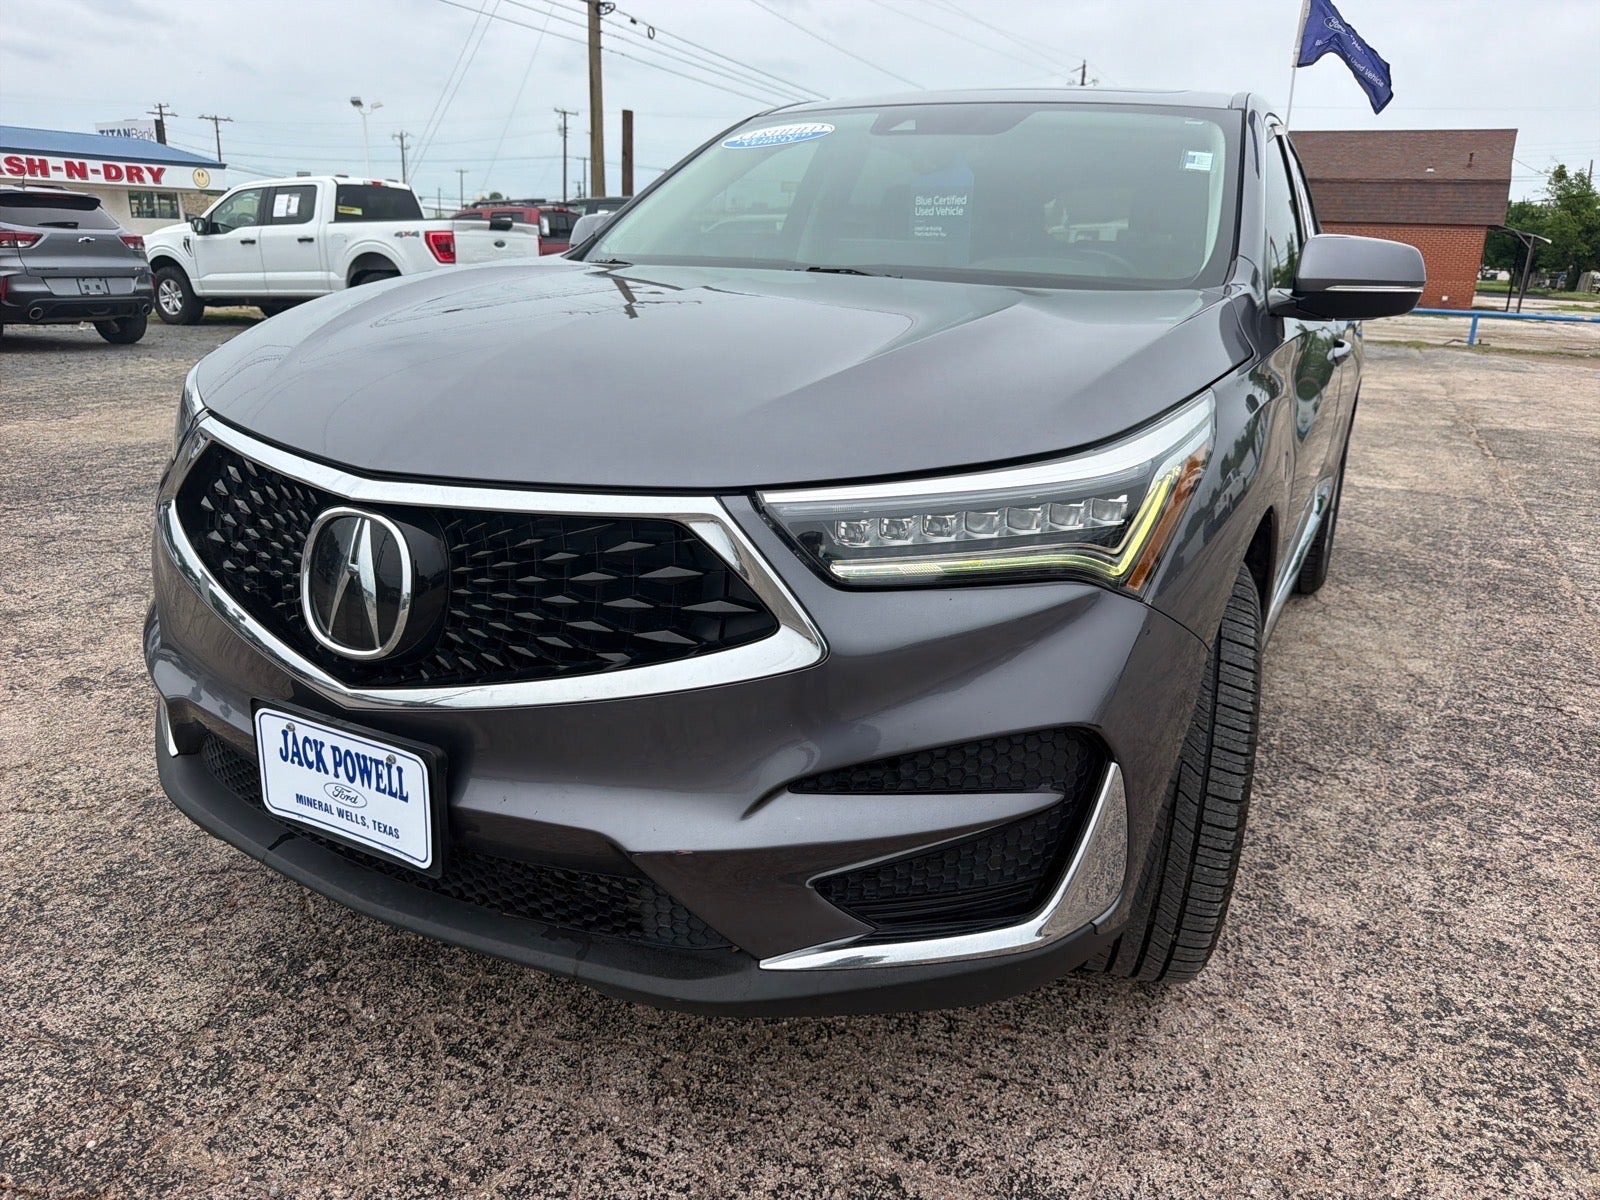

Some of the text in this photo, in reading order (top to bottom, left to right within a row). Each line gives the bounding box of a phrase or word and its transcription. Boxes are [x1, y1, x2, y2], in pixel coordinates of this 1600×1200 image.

[1350, 57, 1385, 88] Used Vehicle
[0, 155, 166, 184] SH-N-DRY
[914, 206, 964, 216] Used Vehicle
[915, 194, 967, 206] Blue Certified
[279, 729, 408, 803] JACK POWELL
[331, 785, 359, 805] Ford
[295, 793, 401, 840] MINERAL WELLS, TEXAS
